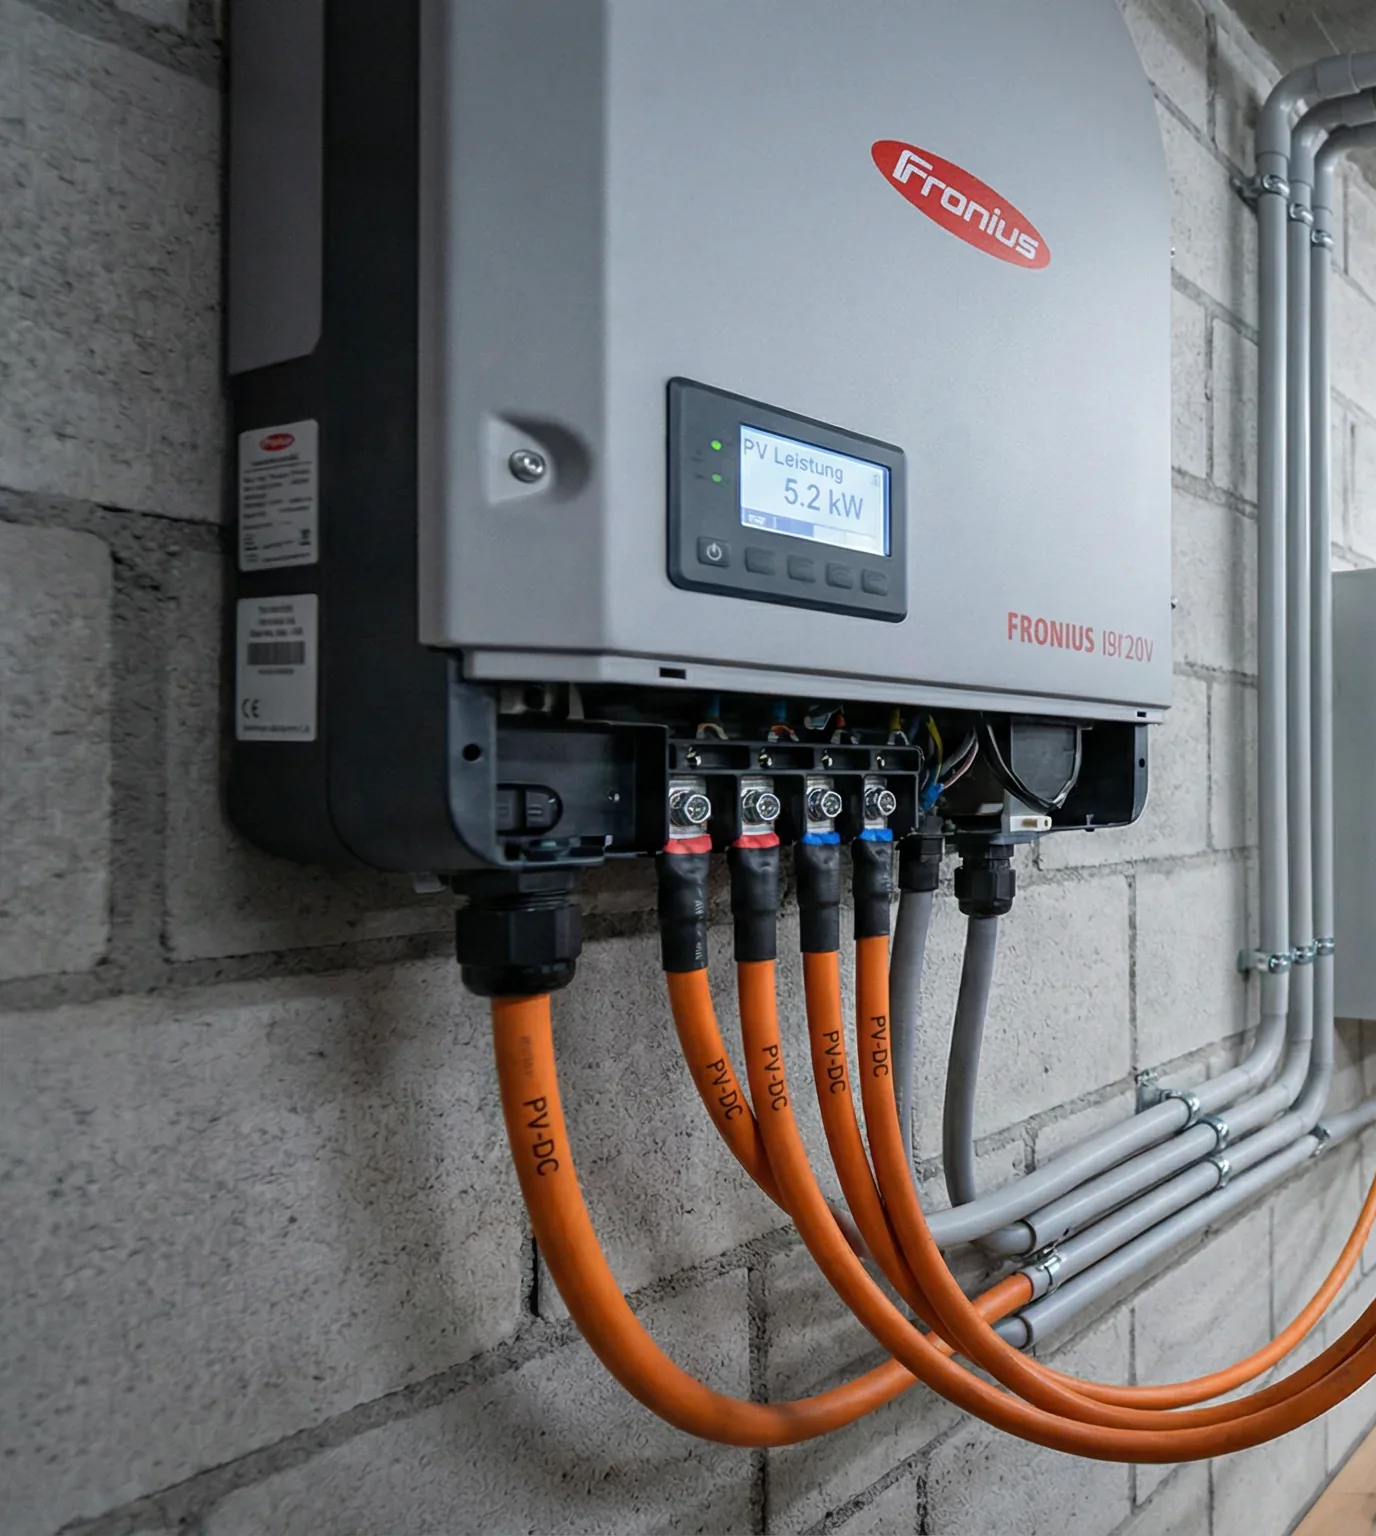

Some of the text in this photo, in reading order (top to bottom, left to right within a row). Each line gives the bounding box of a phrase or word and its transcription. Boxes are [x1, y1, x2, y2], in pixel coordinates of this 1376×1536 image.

[892, 149, 1039, 260] Fronius
[743, 438, 844, 484] PV Leistung
[784, 478, 864, 521] 5.2 kW
[1007, 611, 1095, 654] FRONIUS
[761, 1044, 787, 1112] PV-DC
[822, 1030, 846, 1095] PV-DC
[870, 1015, 889, 1078] PV-DC
[705, 1058, 743, 1121] PV-DC
[523, 1096, 559, 1177] PV-DC
